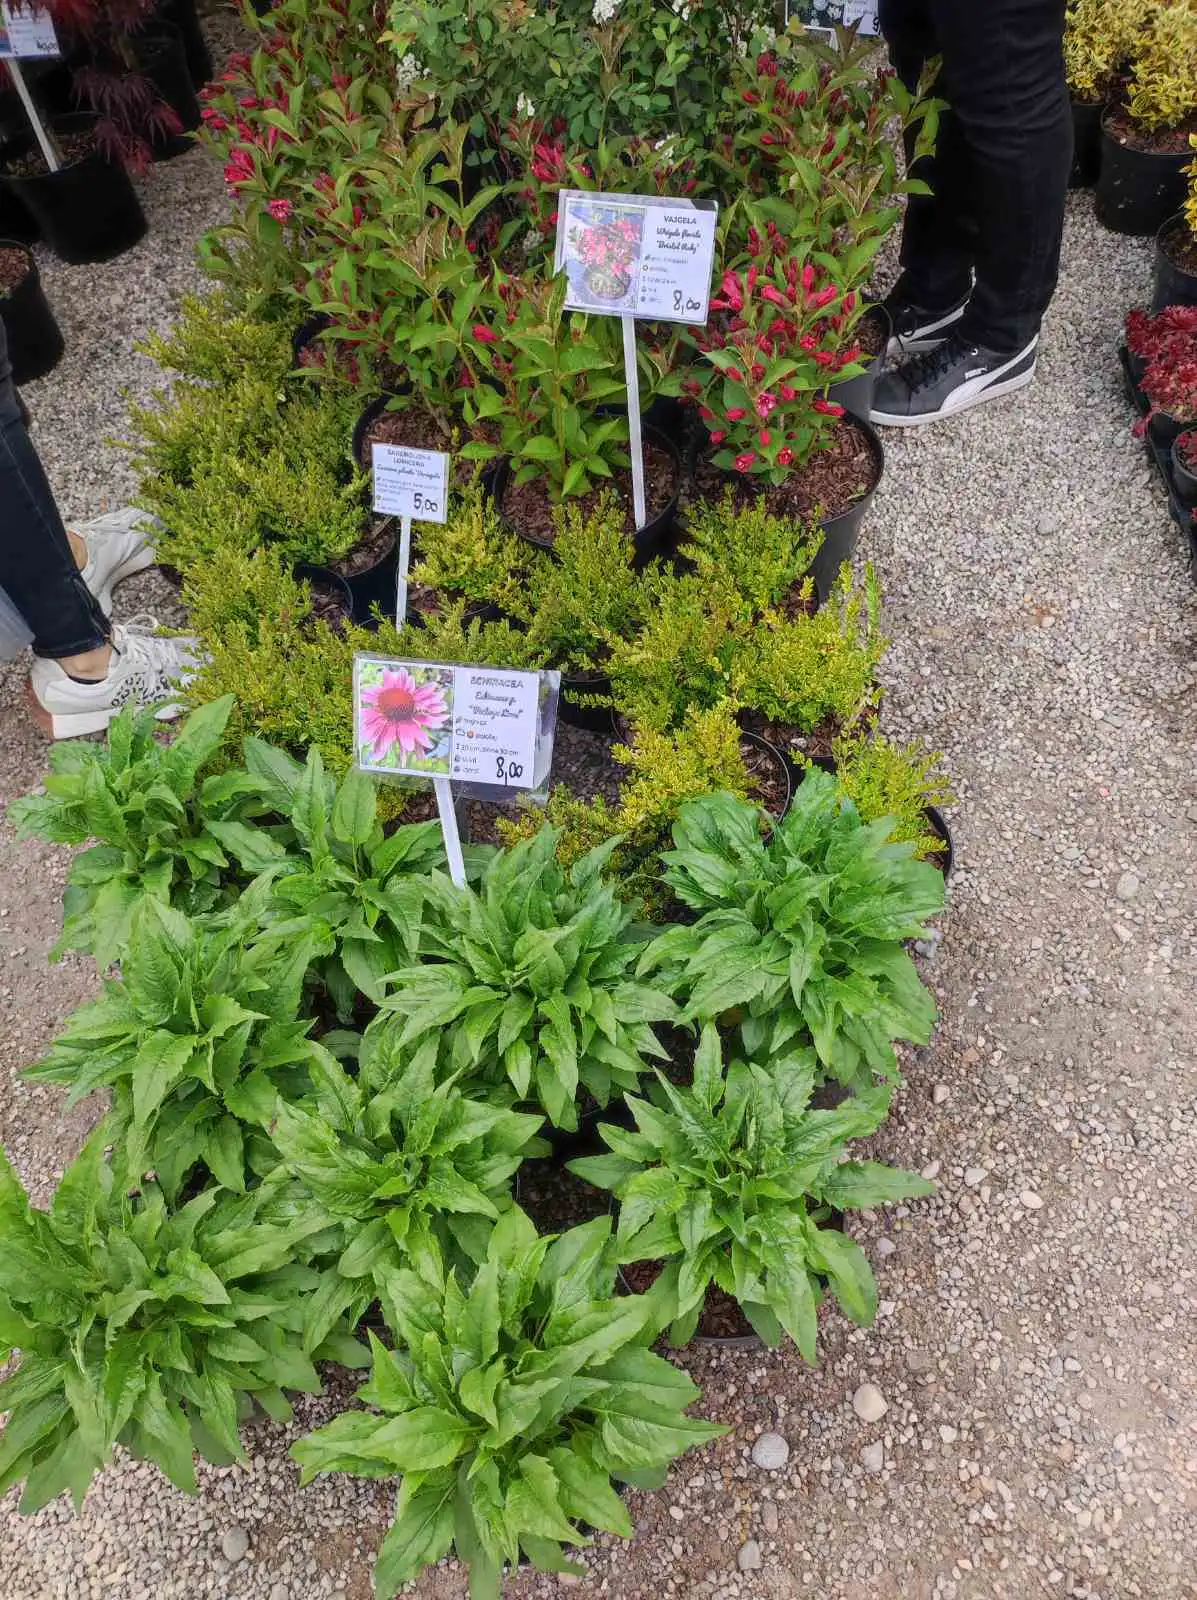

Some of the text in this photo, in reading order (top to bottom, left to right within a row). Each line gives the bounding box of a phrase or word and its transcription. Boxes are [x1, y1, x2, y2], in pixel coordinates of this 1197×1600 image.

[663, 215, 697, 225] VAJGELA
[673, 289, 701, 315] 8,00
[414, 492, 438, 516] 5,00
[496, 756, 523, 788] 8,00
